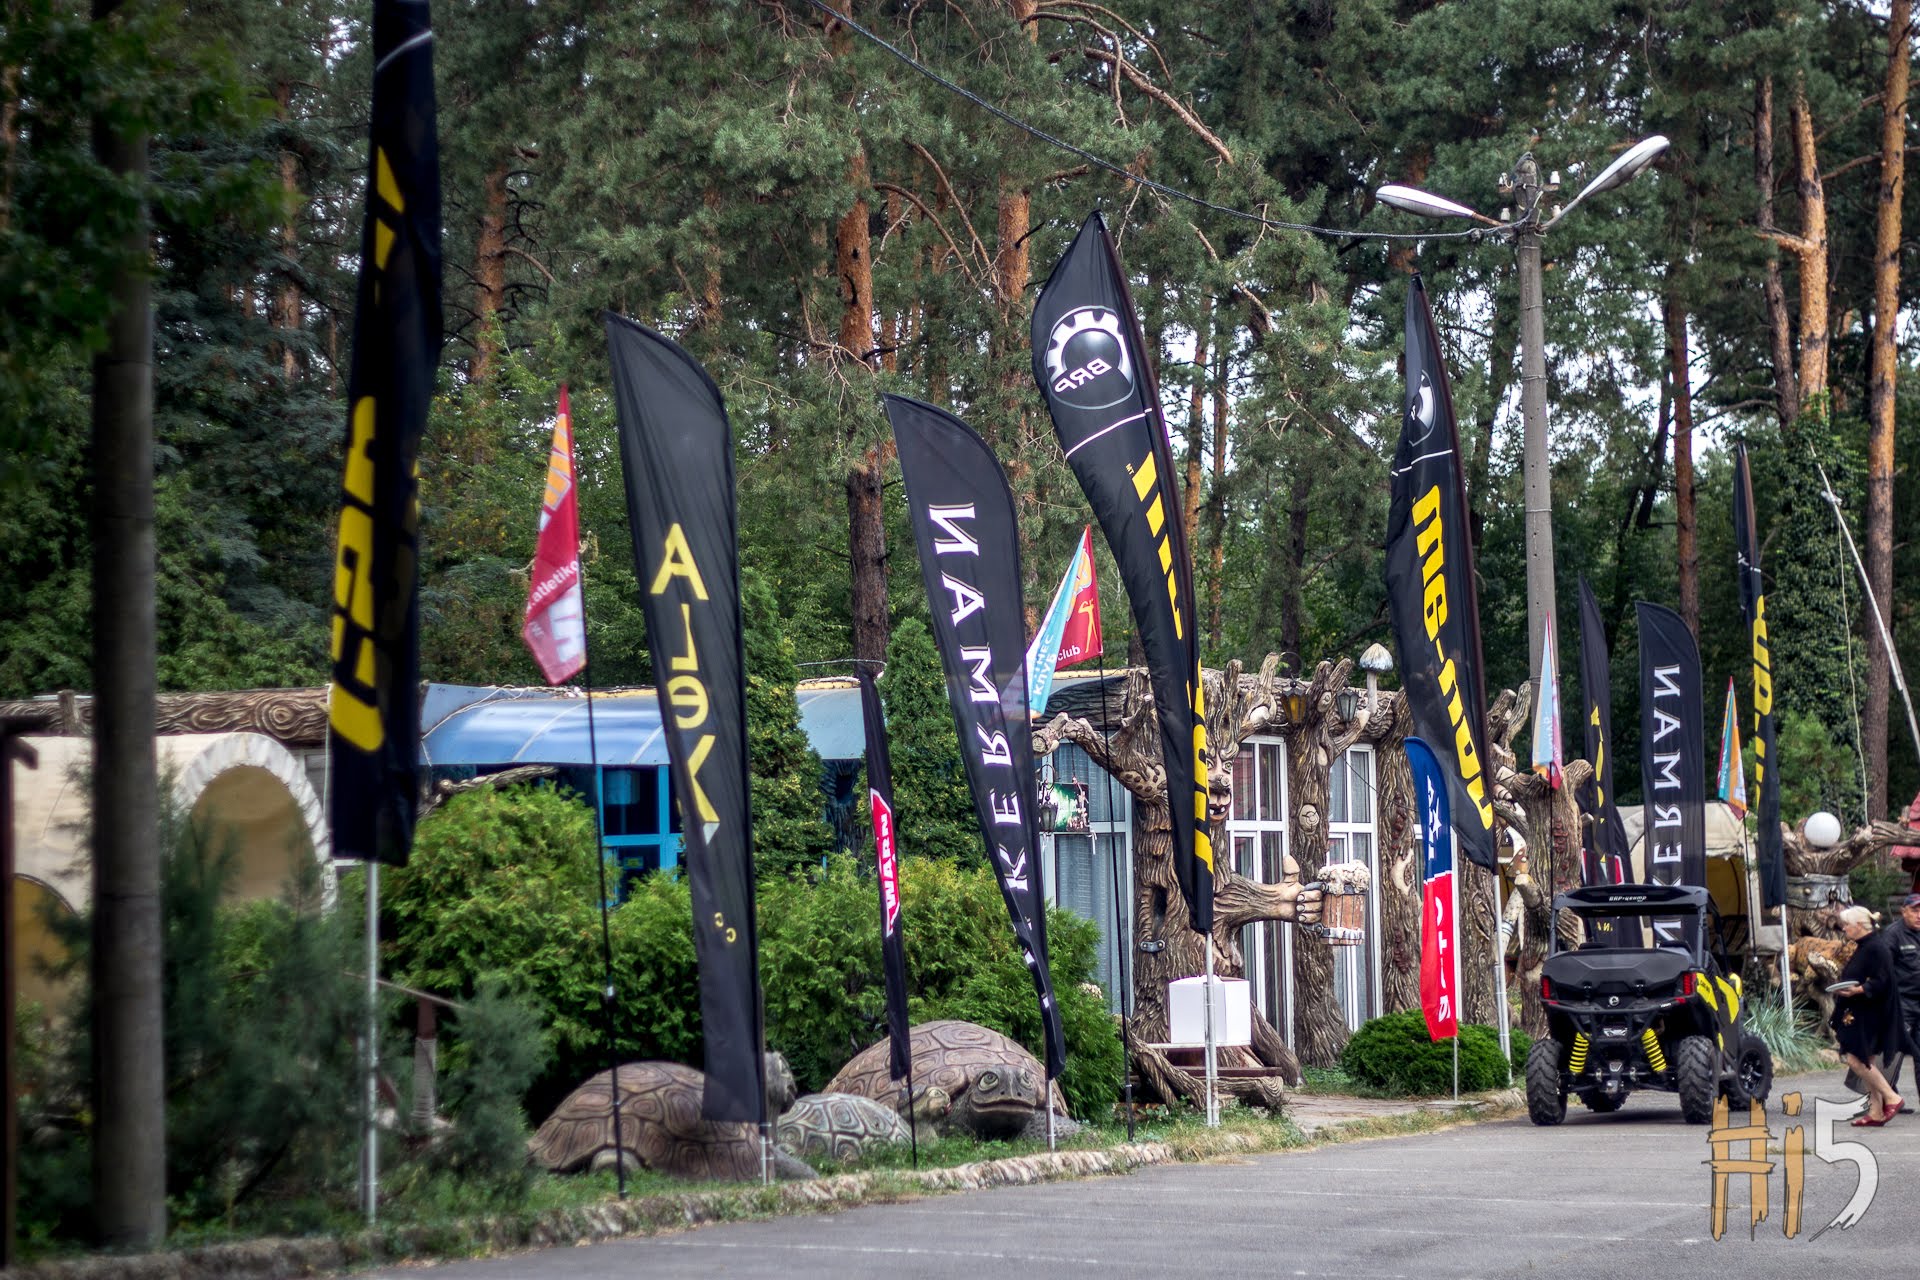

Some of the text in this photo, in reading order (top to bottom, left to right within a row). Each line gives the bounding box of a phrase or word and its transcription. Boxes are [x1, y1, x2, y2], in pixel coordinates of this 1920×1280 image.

[1033, 653, 1058, 695] КЛУБ
[1057, 645, 1081, 661] club
[881, 814, 896, 909] WARN
